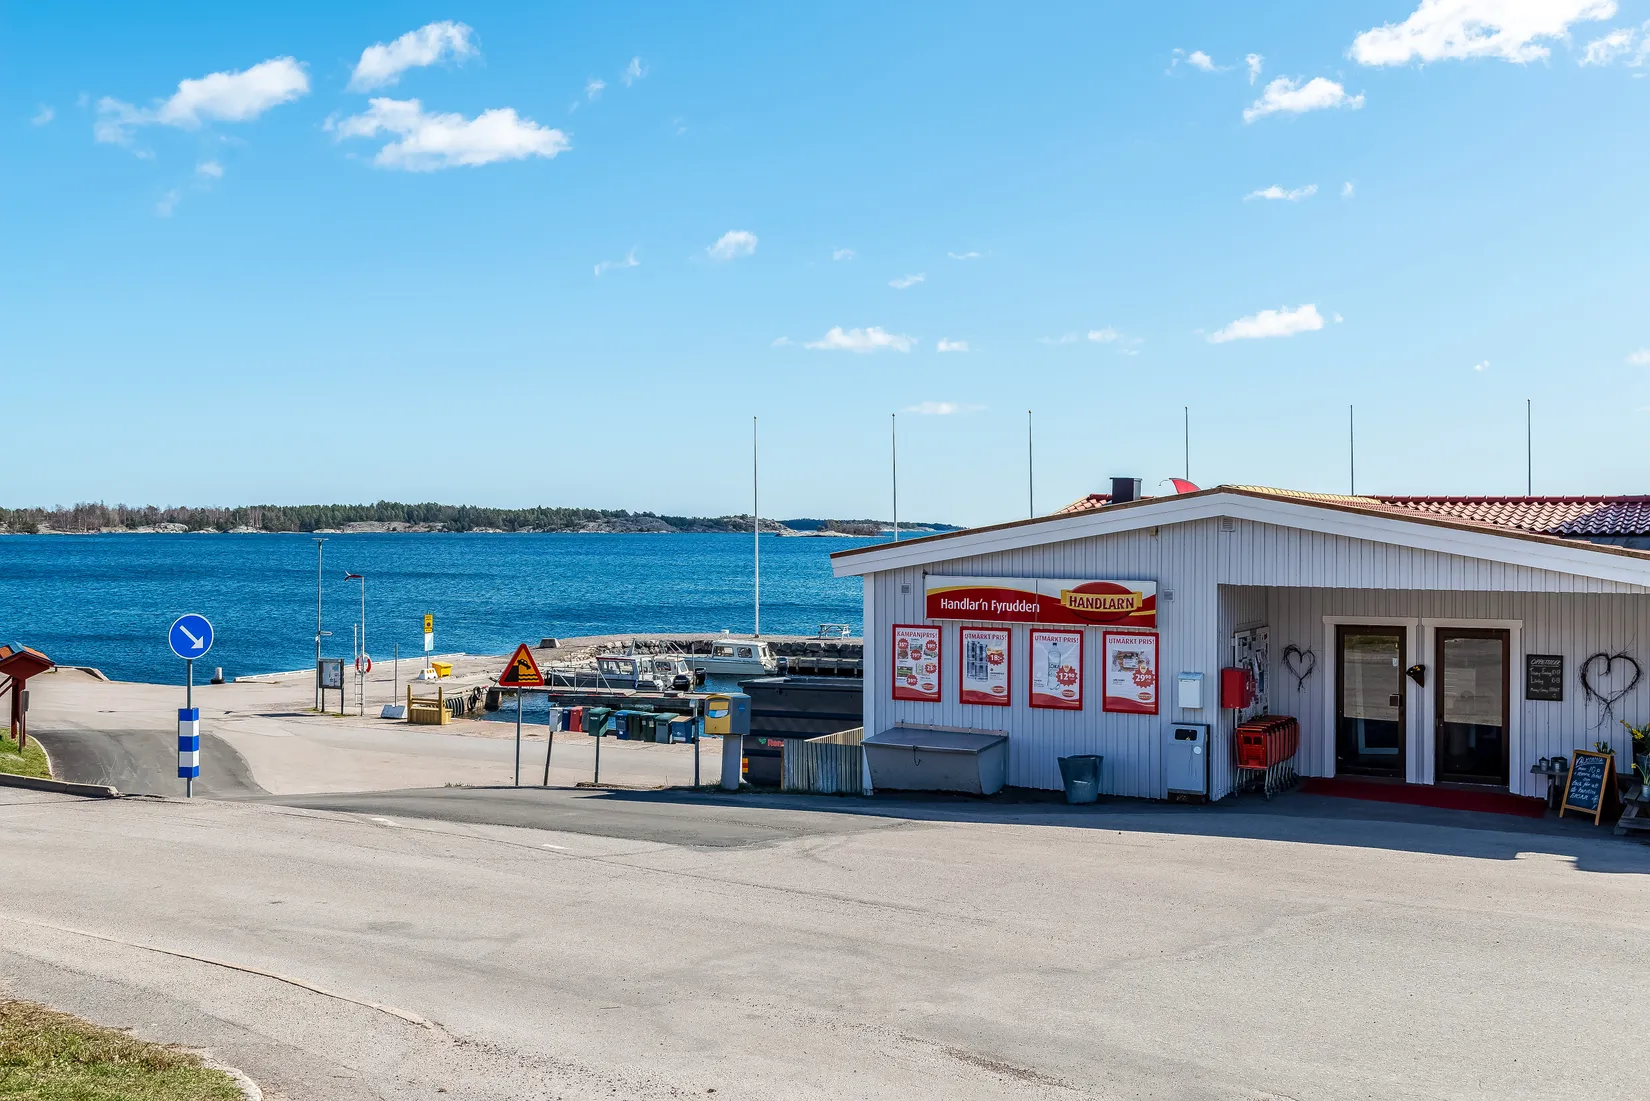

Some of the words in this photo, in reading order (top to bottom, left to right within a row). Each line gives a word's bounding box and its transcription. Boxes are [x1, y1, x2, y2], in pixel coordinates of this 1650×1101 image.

[940, 598, 988, 611] Handlar'n
[991, 600, 1040, 614] Fyrudden
[896, 631, 938, 639] KAMPANJPRIS!
